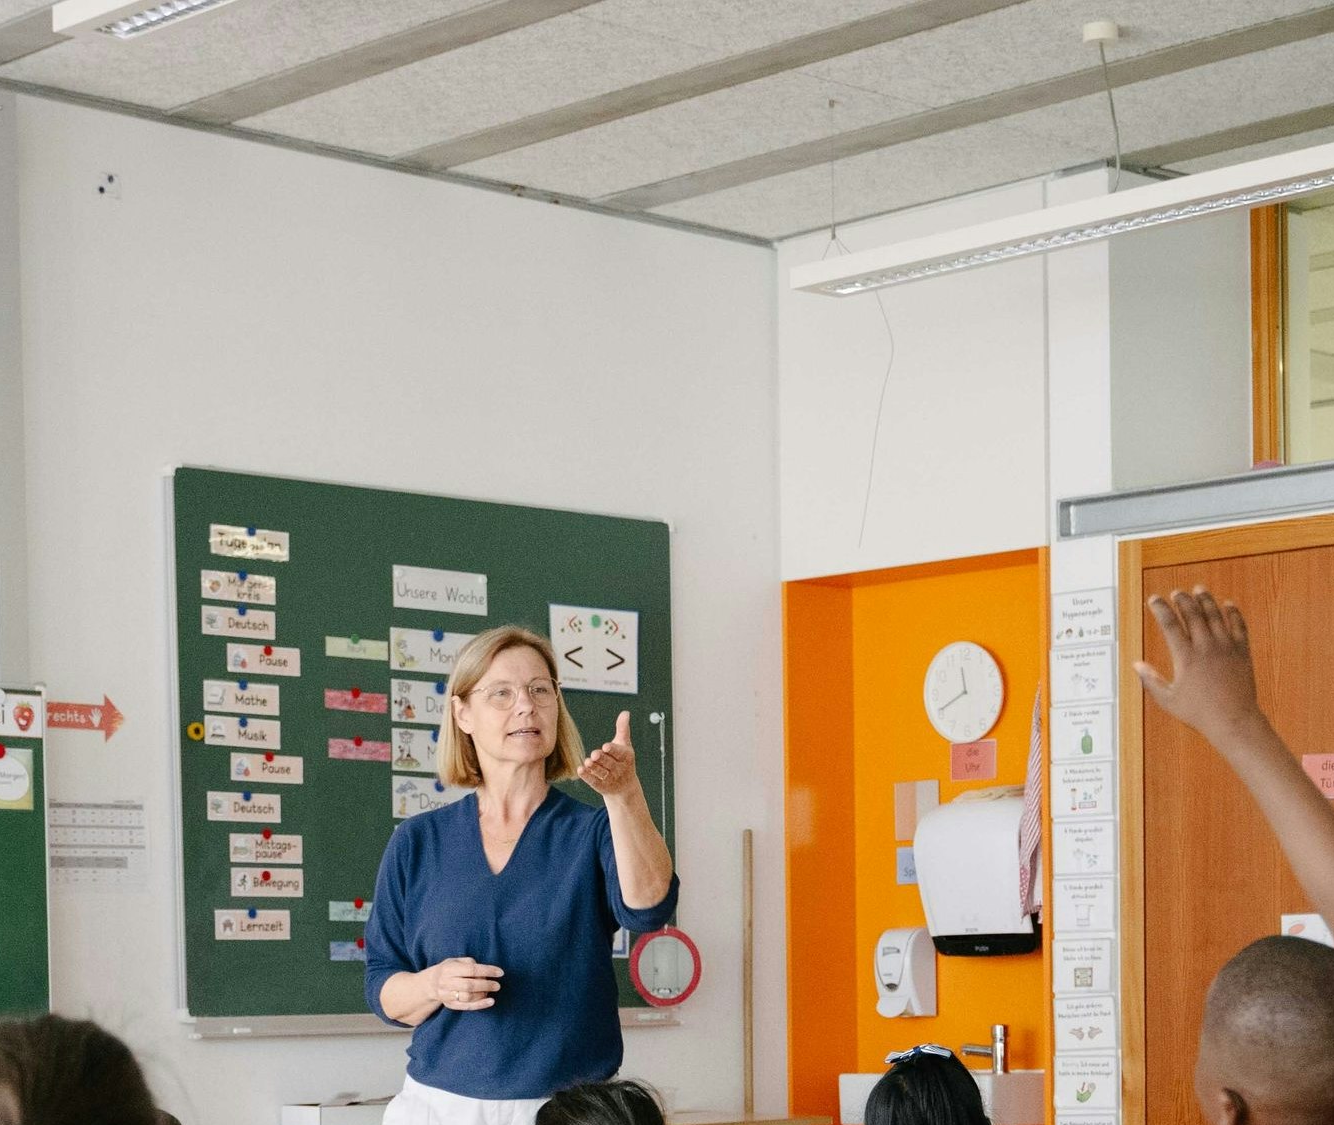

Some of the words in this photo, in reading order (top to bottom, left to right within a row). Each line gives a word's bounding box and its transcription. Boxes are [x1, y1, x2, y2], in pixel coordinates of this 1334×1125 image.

[396, 583, 438, 602] Unsere
[445, 587, 485, 607] Woche
[228, 617, 269, 631] Deutsch
[259, 655, 288, 668] Pause
[235, 693, 267, 706] Mathe
[47, 711, 87, 724] rechts
[238, 729, 267, 742] Musik
[262, 762, 291, 775] Pause
[233, 802, 274, 815] Deutsch
[255, 840, 297, 855] Mittags-
[255, 850, 283, 862] pause
[253, 877, 299, 891] Bewegung
[240, 916, 284, 932] Lernzeit
